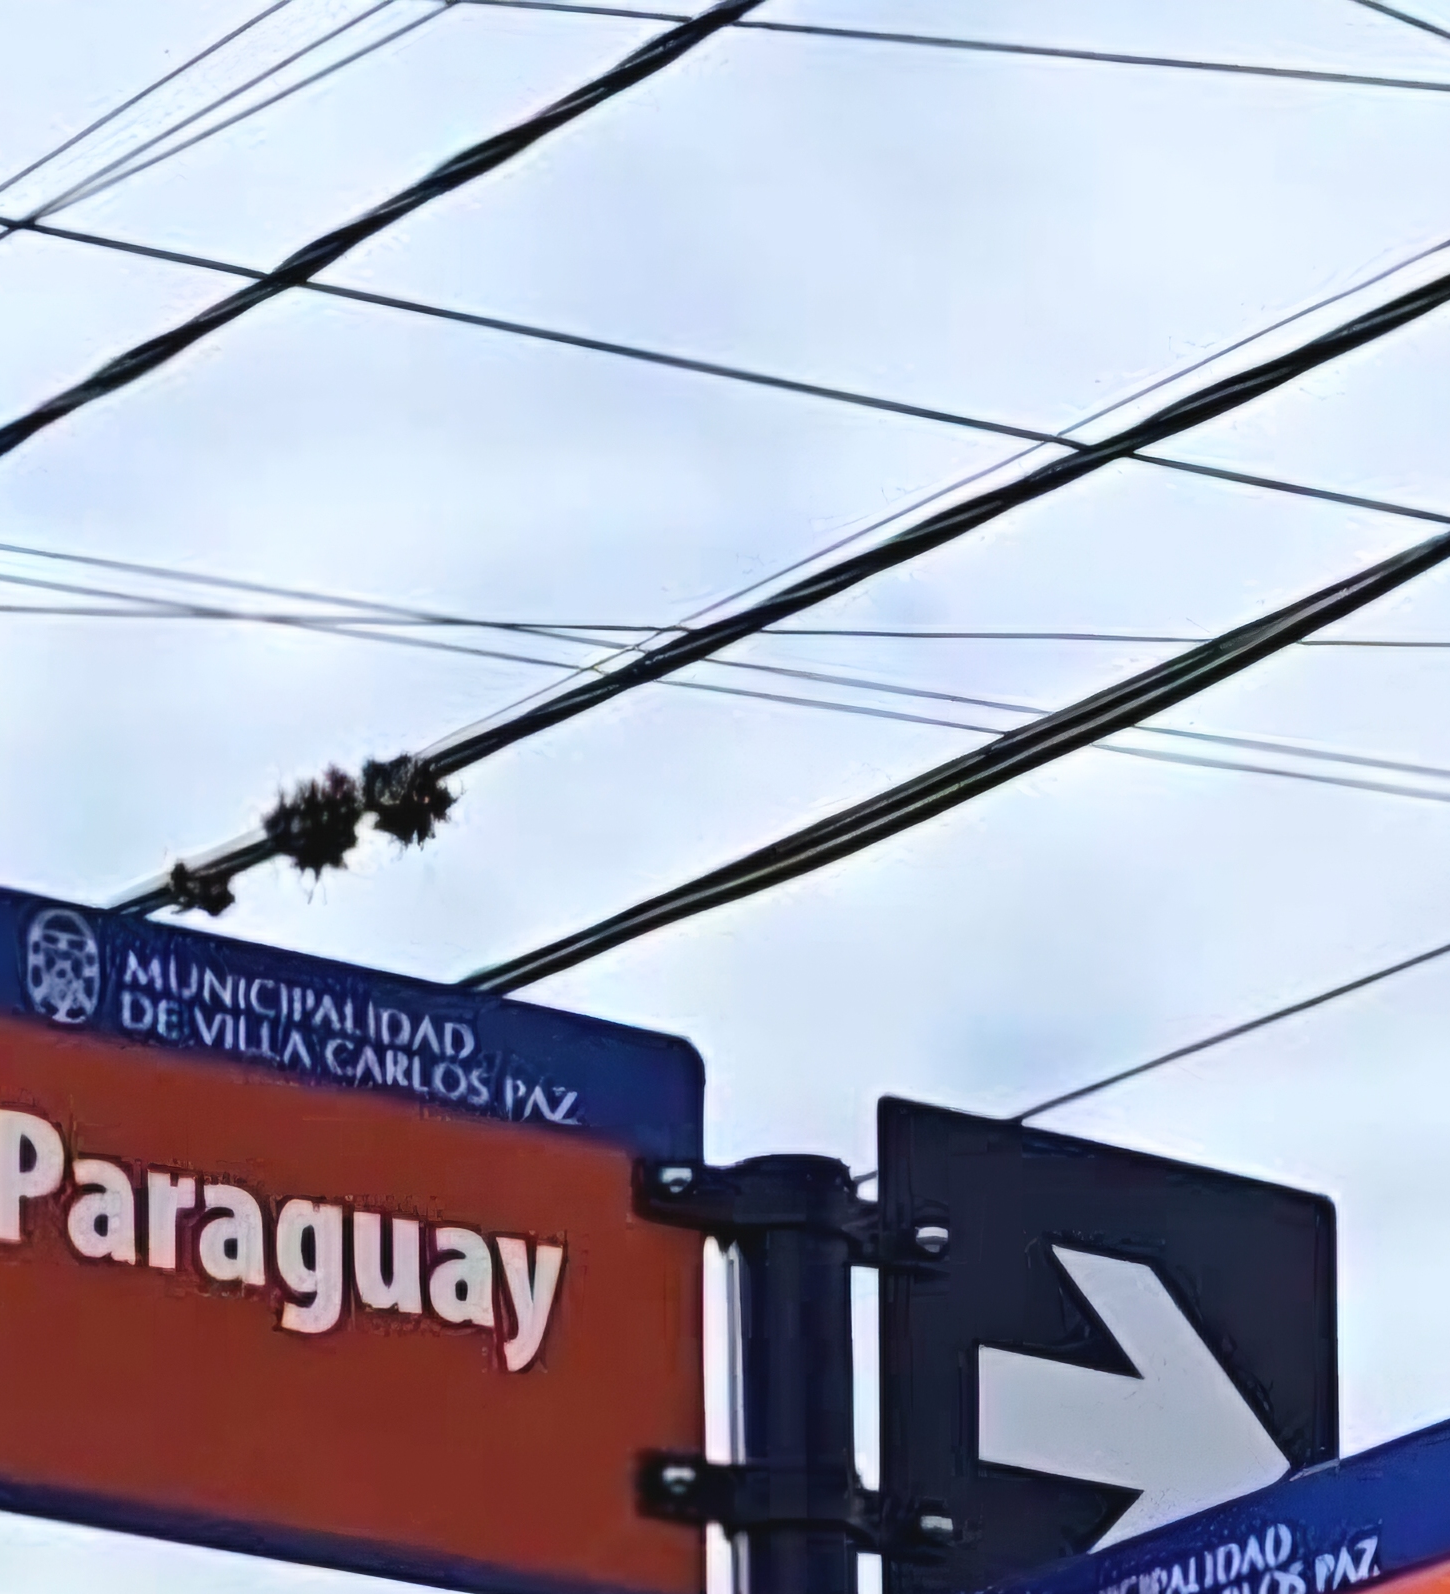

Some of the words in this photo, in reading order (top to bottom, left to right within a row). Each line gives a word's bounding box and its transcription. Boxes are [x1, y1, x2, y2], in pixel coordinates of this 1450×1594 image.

[121, 992, 184, 1040] DE
[194, 1007, 313, 1070] VILLA
[325, 1039, 490, 1104] CARLOS
[505, 1076, 580, 1125] PAZ
[124, 949, 476, 1060] MUNICIPALIDAD
[1316, 1535, 1381, 1594] PAZ
